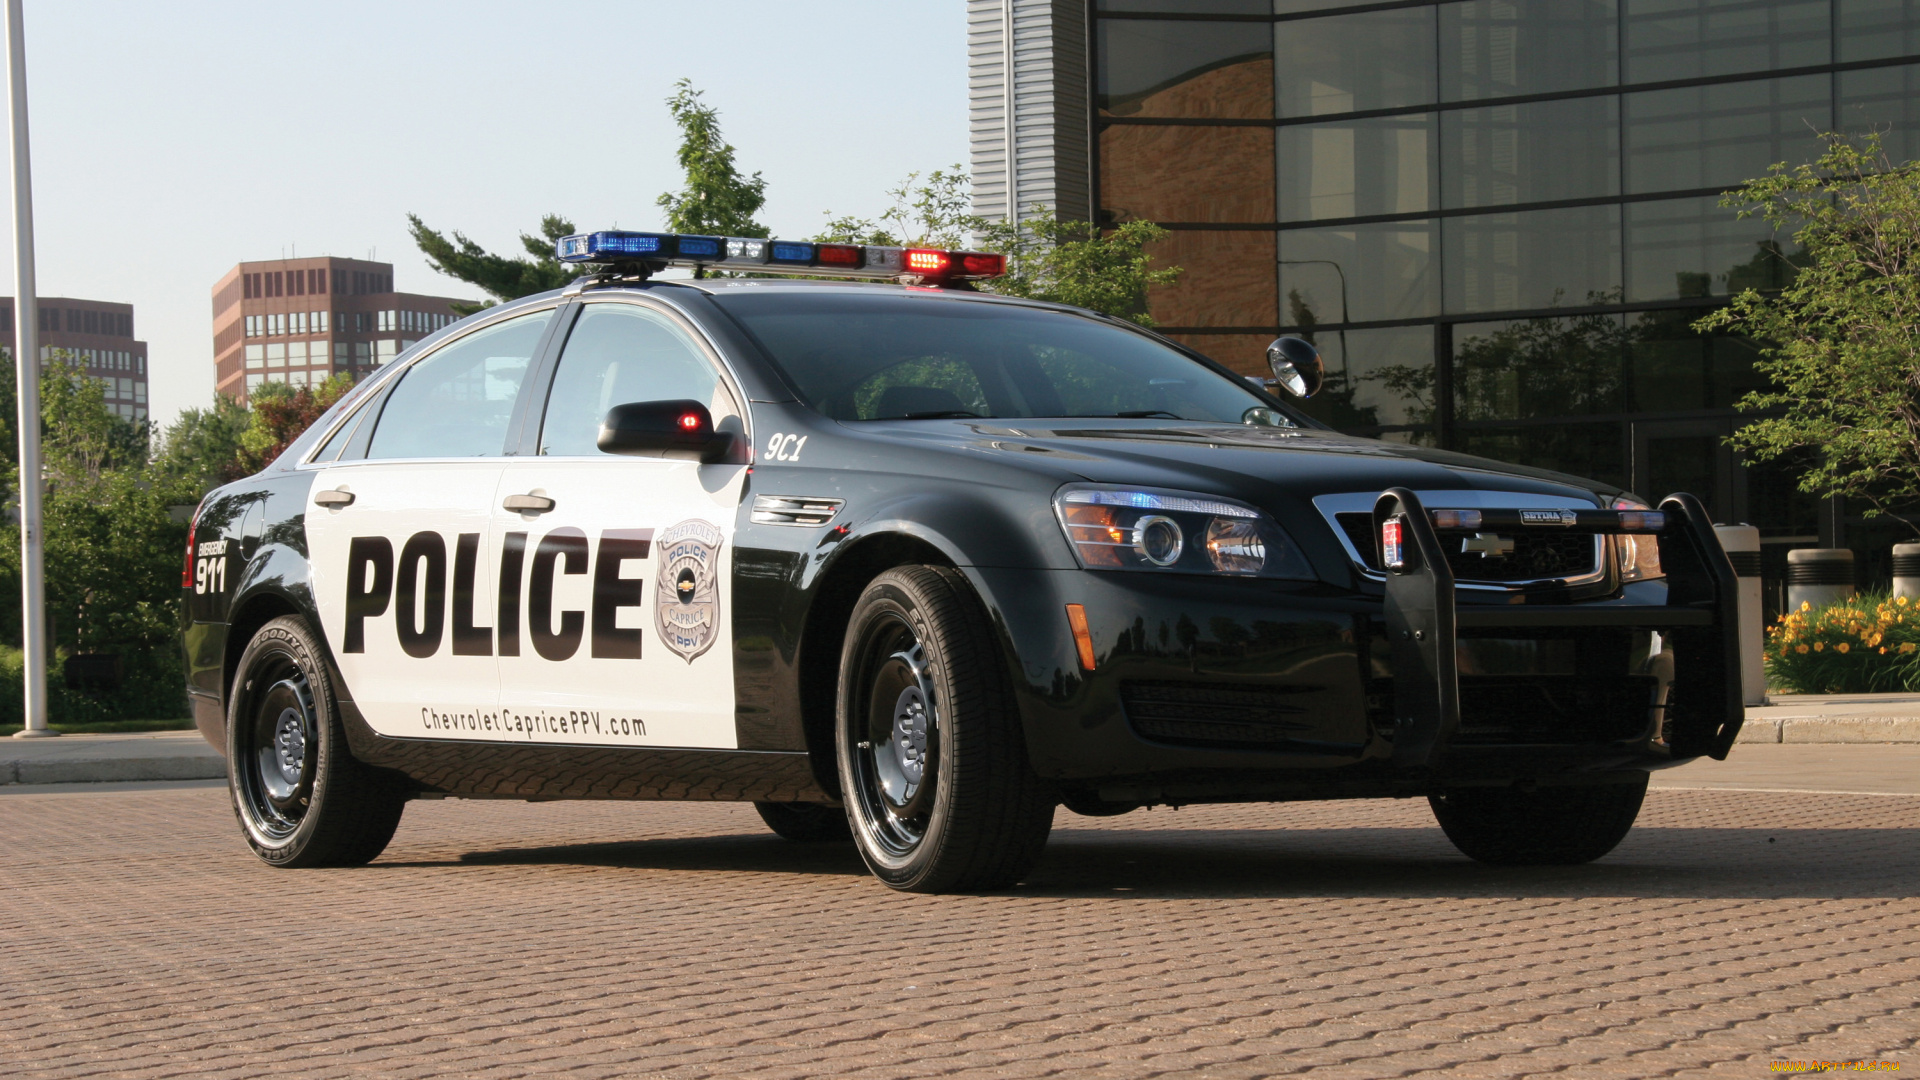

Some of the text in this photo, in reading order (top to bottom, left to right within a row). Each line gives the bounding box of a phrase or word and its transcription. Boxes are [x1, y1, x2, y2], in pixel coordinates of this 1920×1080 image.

[764, 433, 808, 461] 9C1
[665, 523, 716, 545] CHEVROLET
[669, 544, 708, 563] POLICE
[195, 556, 227, 594] 911
[342, 526, 655, 661] POLICE
[669, 608, 705, 625] CAPRICE
[676, 634, 699, 648] PPV
[421, 706, 647, 739] ChevroletCapricePPV.com
